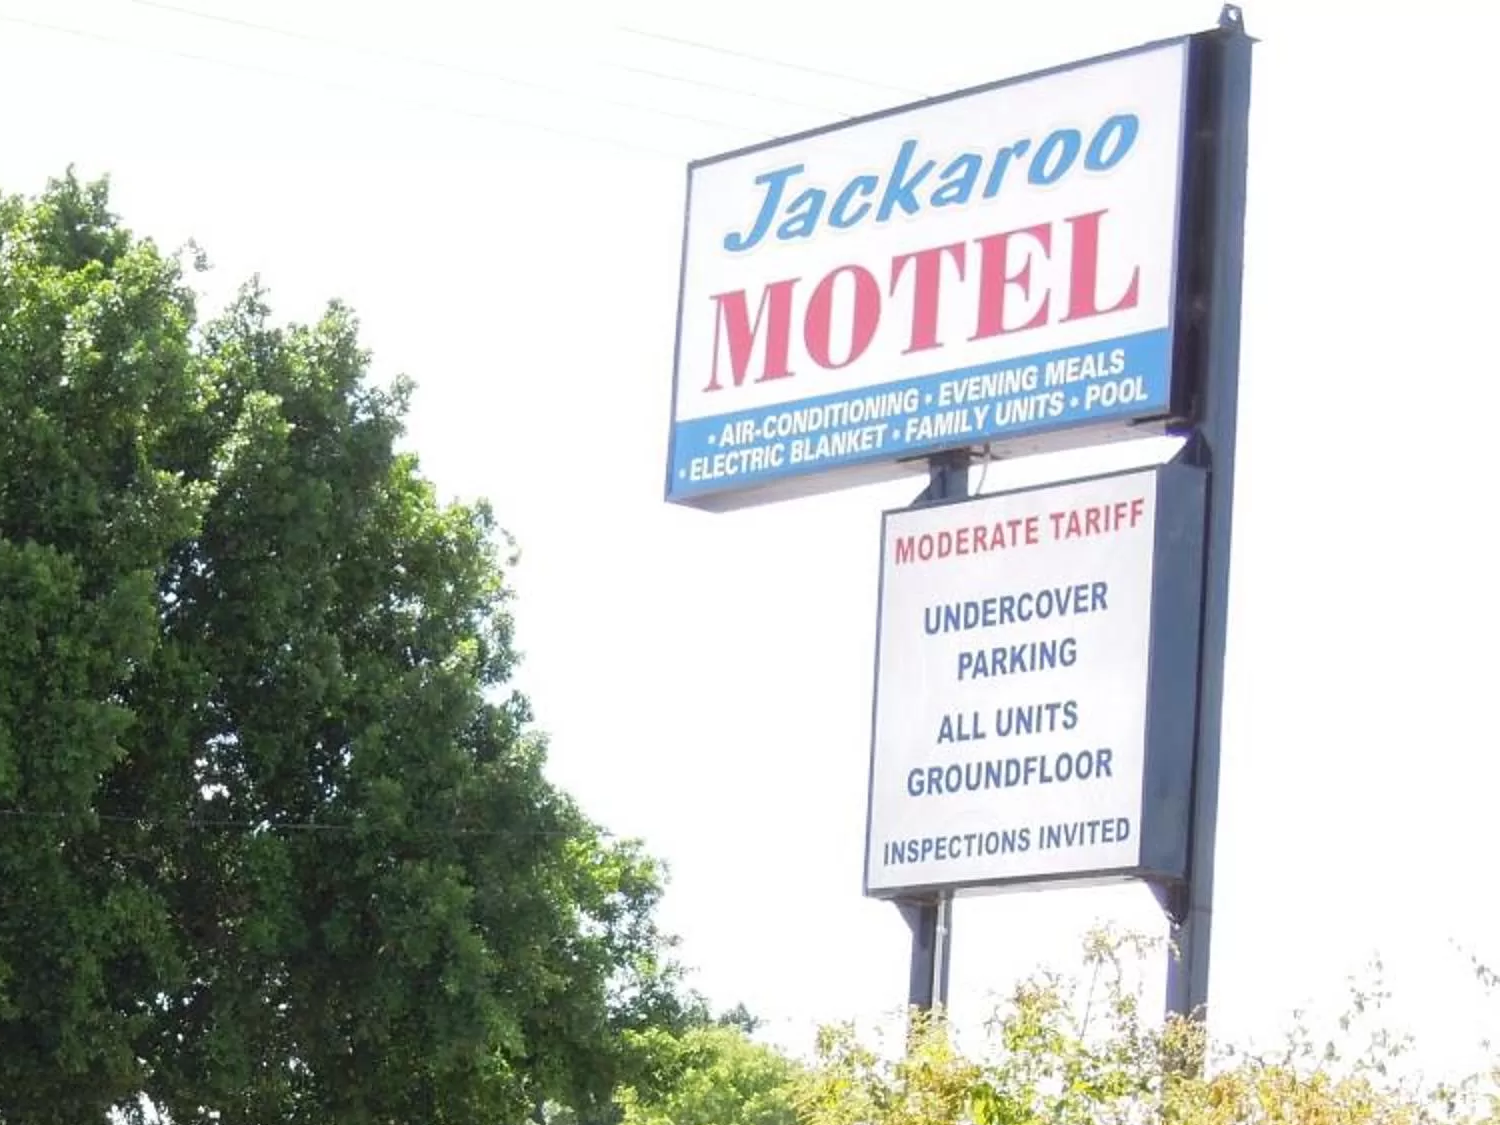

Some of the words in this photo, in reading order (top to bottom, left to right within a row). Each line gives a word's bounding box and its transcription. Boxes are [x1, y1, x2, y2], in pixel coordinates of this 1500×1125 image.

[723, 113, 1140, 252] Jackaroo
[702, 208, 1141, 393] MOTEL
[719, 387, 919, 447] AIR-CONDITIONING
[938, 365, 1038, 407] EVENING
[1045, 348, 1126, 387] MEALS
[689, 443, 785, 481] ELECTRIC
[790, 423, 888, 465] BLANKET
[904, 404, 991, 442] FAMILY
[995, 391, 1065, 425] UNITS
[1085, 375, 1148, 410] POOL
[895, 515, 1040, 565] MODERATE
[1049, 498, 1145, 541] TARIFF
[924, 581, 1108, 635] UNDERCOVER
[957, 637, 1077, 681] PARKING
[937, 711, 986, 744] ALL
[995, 700, 1078, 737] UNITS
[907, 748, 1113, 797] GROUNDFLOOR
[884, 827, 1031, 866] INSPECTIONS
[1039, 817, 1130, 849] INVITED
